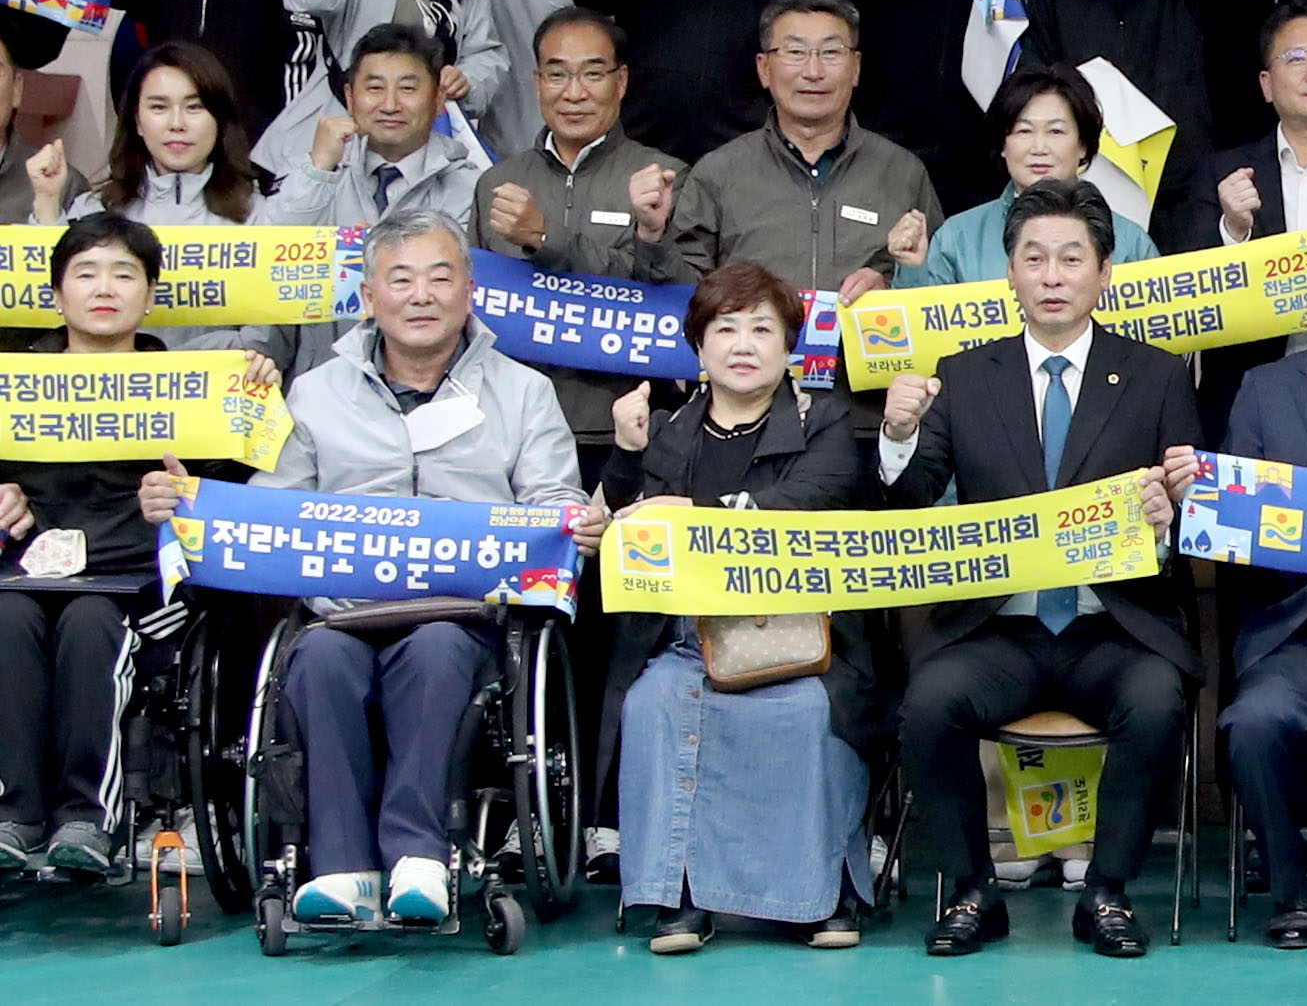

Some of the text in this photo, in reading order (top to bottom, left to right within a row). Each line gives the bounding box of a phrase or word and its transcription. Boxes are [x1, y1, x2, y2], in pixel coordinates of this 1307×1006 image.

[275, 242, 327, 262] 2023
[271, 264, 330, 281] 전남으로
[279, 284, 322, 300] 오세요
[533, 273, 643, 303] 2022-2023
[921, 299, 1008, 331] 제43회
[867, 359, 914, 373] 전라남도
[11, 412, 174, 442] 전국체육대회
[299, 502, 420, 526] 2022-2023
[1058, 501, 1113, 528] 2023
[688, 513, 1039, 557] 제43회 전국장애인체육대회
[1056, 521, 1118, 547] 전남으로
[212, 520, 527, 589] 전라남도 방문의 해
[1066, 542, 1112, 564] 오세요
[623, 578, 672, 593] 전라남도
[724, 554, 1009, 594] 제104회 전국체육대회
